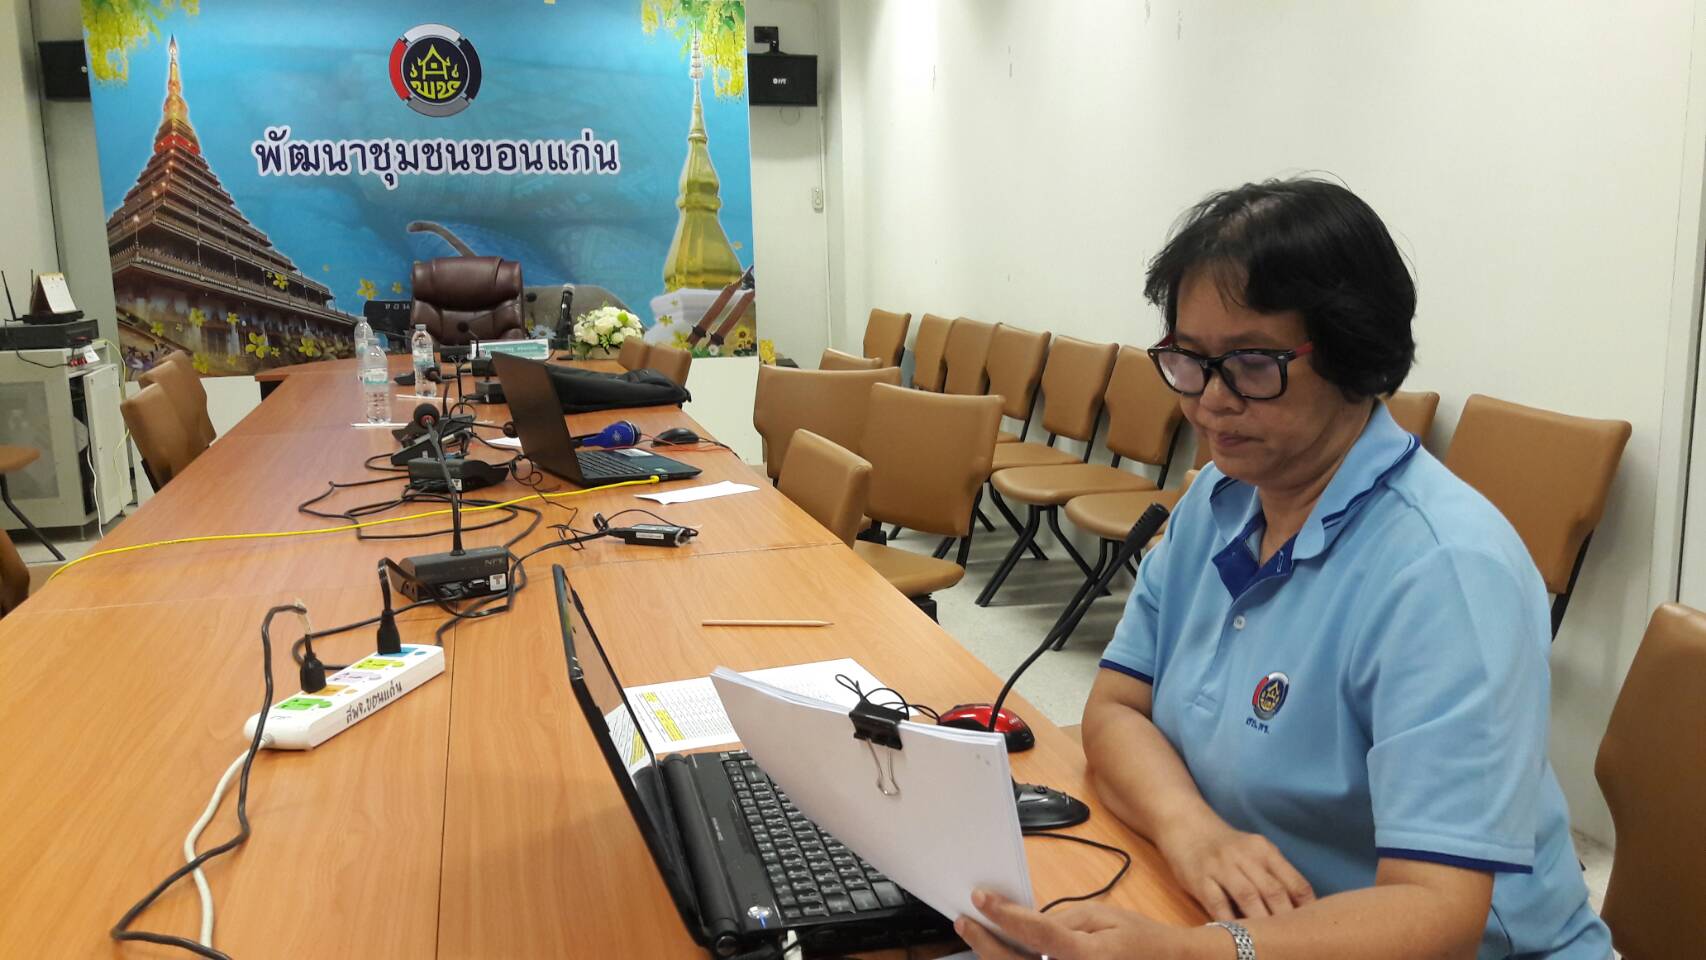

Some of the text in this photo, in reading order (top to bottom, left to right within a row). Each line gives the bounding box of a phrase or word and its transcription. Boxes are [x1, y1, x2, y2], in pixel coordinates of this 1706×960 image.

[254, 128, 617, 187] พัฒนาชุมชนขอนแก่น
